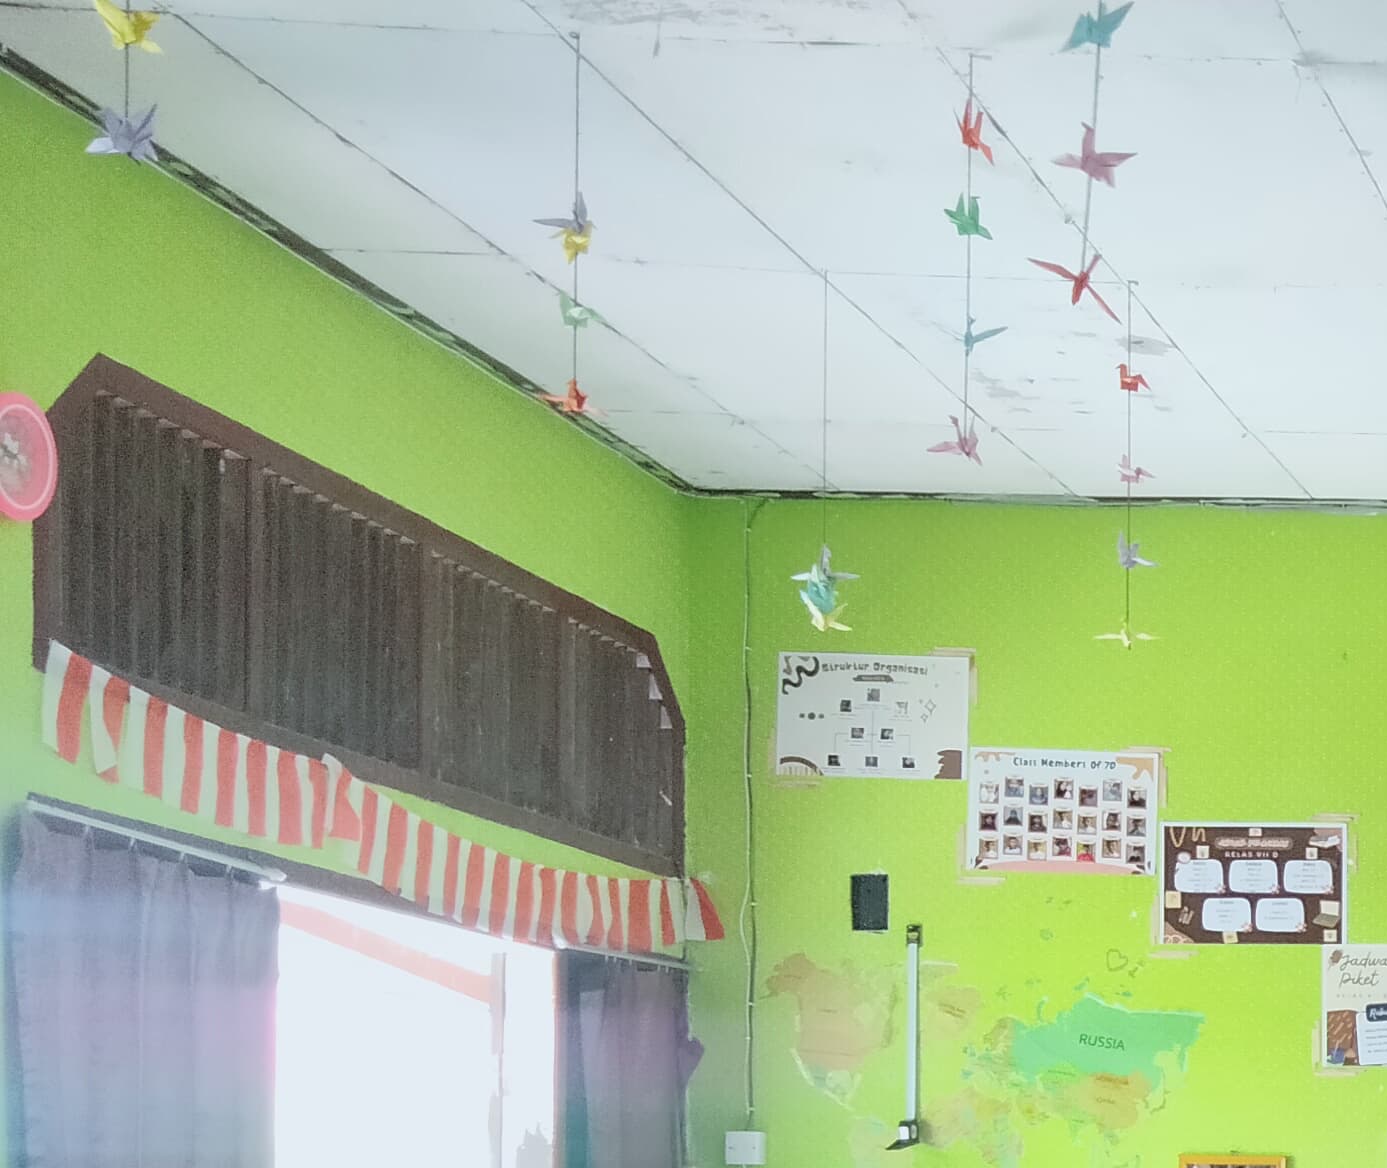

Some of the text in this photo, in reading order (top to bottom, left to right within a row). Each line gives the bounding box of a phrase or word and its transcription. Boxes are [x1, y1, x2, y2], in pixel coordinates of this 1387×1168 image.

[1013, 757, 1037, 767] Class
[1041, 758, 1086, 769] Members
[1339, 971, 1381, 988] Piket
[1079, 1033, 1125, 1051] RUSSIA
